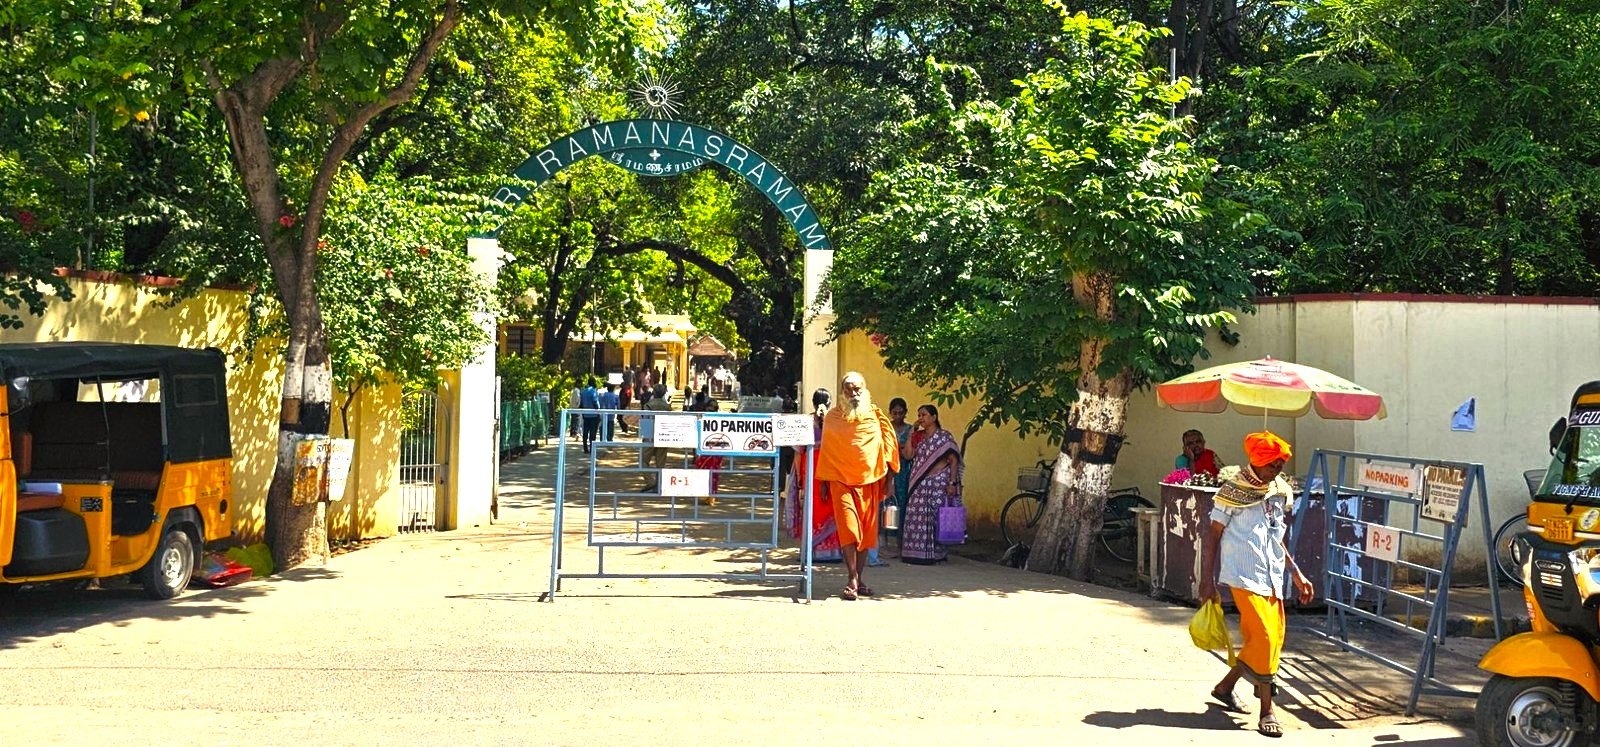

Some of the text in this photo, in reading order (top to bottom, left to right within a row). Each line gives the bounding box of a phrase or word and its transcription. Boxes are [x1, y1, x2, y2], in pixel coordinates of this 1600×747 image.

[536, 121, 826, 245] RAMANASRAMAM
[703, 419, 717, 433] NO
[720, 420, 772, 434] PARKING
[670, 476, 689, 486] R-1
[1372, 531, 1392, 551] R-2
